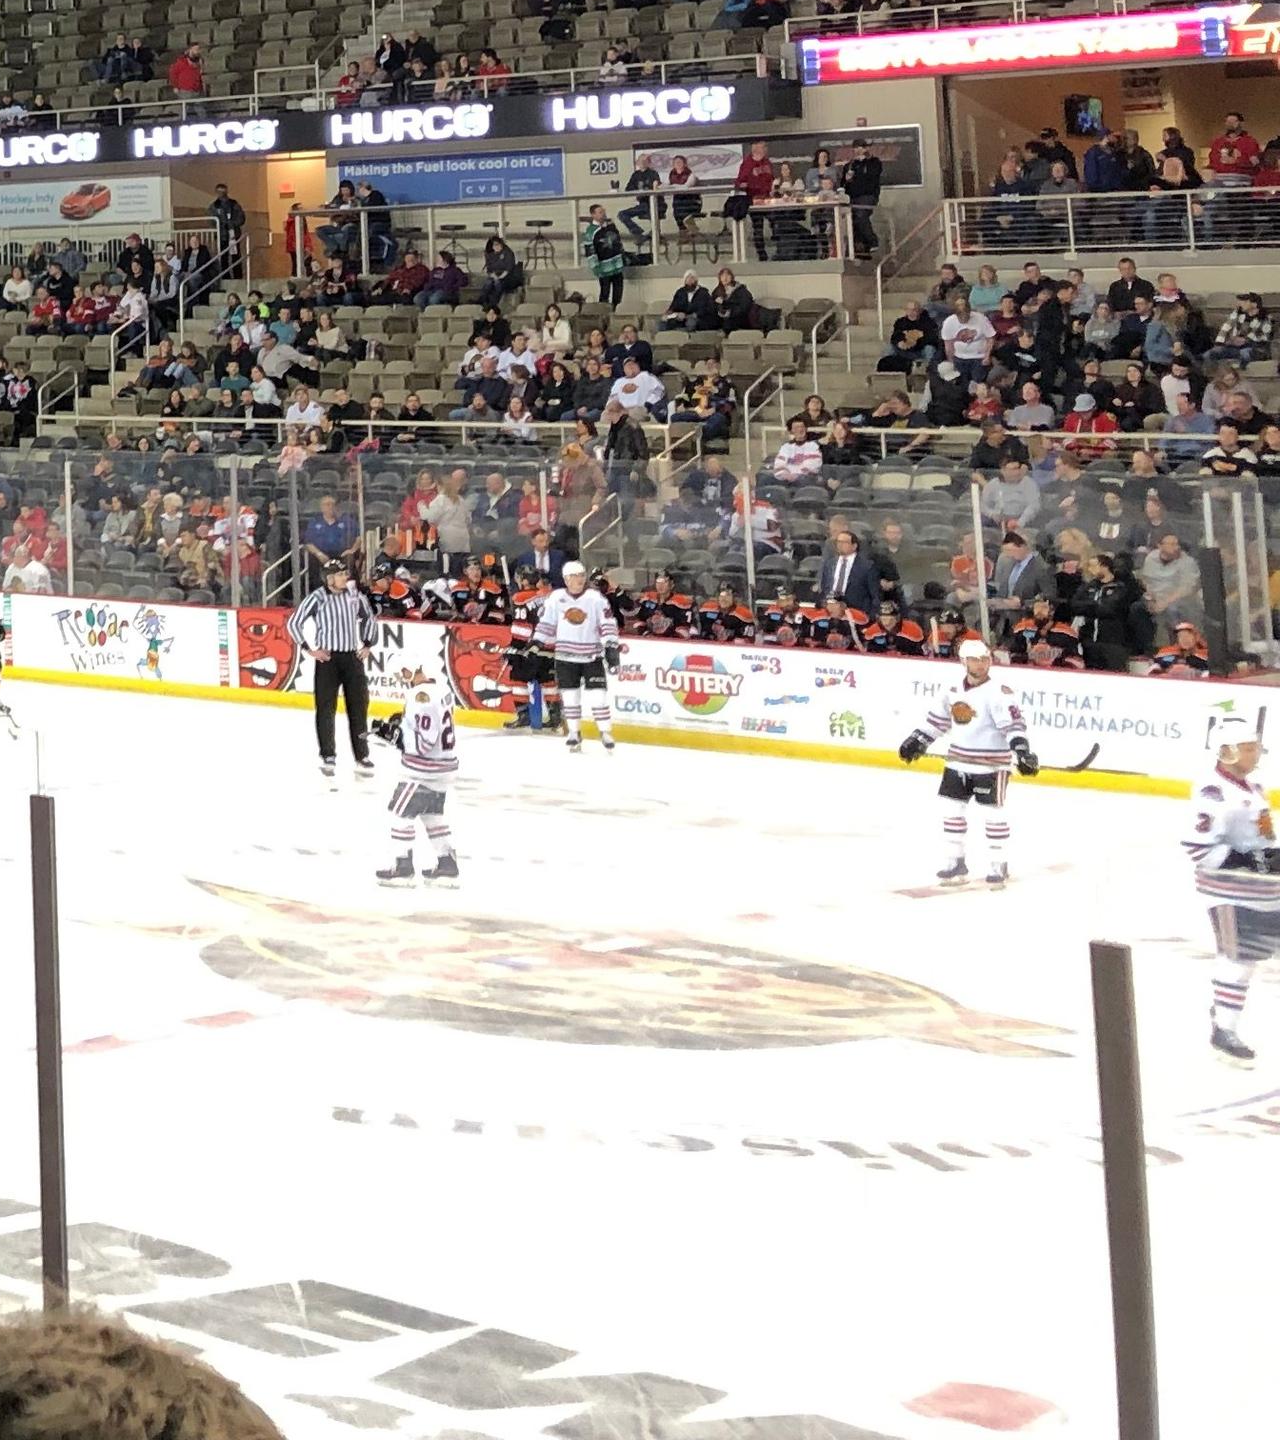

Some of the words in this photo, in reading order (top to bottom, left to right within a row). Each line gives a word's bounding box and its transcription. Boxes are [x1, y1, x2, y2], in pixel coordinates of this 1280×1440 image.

[552, 85, 736, 132] HURCO
[330, 103, 494, 146] HURCO
[133, 119, 280, 159] HURCO
[344, 164, 390, 178] Making
[391, 162, 413, 175] the
[415, 160, 444, 173] Fuel
[446, 158, 476, 172] look
[478, 156, 508, 170] cool
[510, 157, 529, 169] on
[529, 155, 554, 168] ice.
[590, 159, 617, 174] 208
[51, 602, 130, 649] Reggae
[70, 649, 126, 673] Wines
[768, 656, 782, 675] 3
[655, 666, 743, 697] LOTTERY
[842, 670, 857, 689] 4
[614, 694, 662, 715] Lotto
[1052, 691, 1104, 711] THAT
[829, 722, 866, 740] FIVE
[1031, 709, 1183, 740] INDIANAPOLIS
